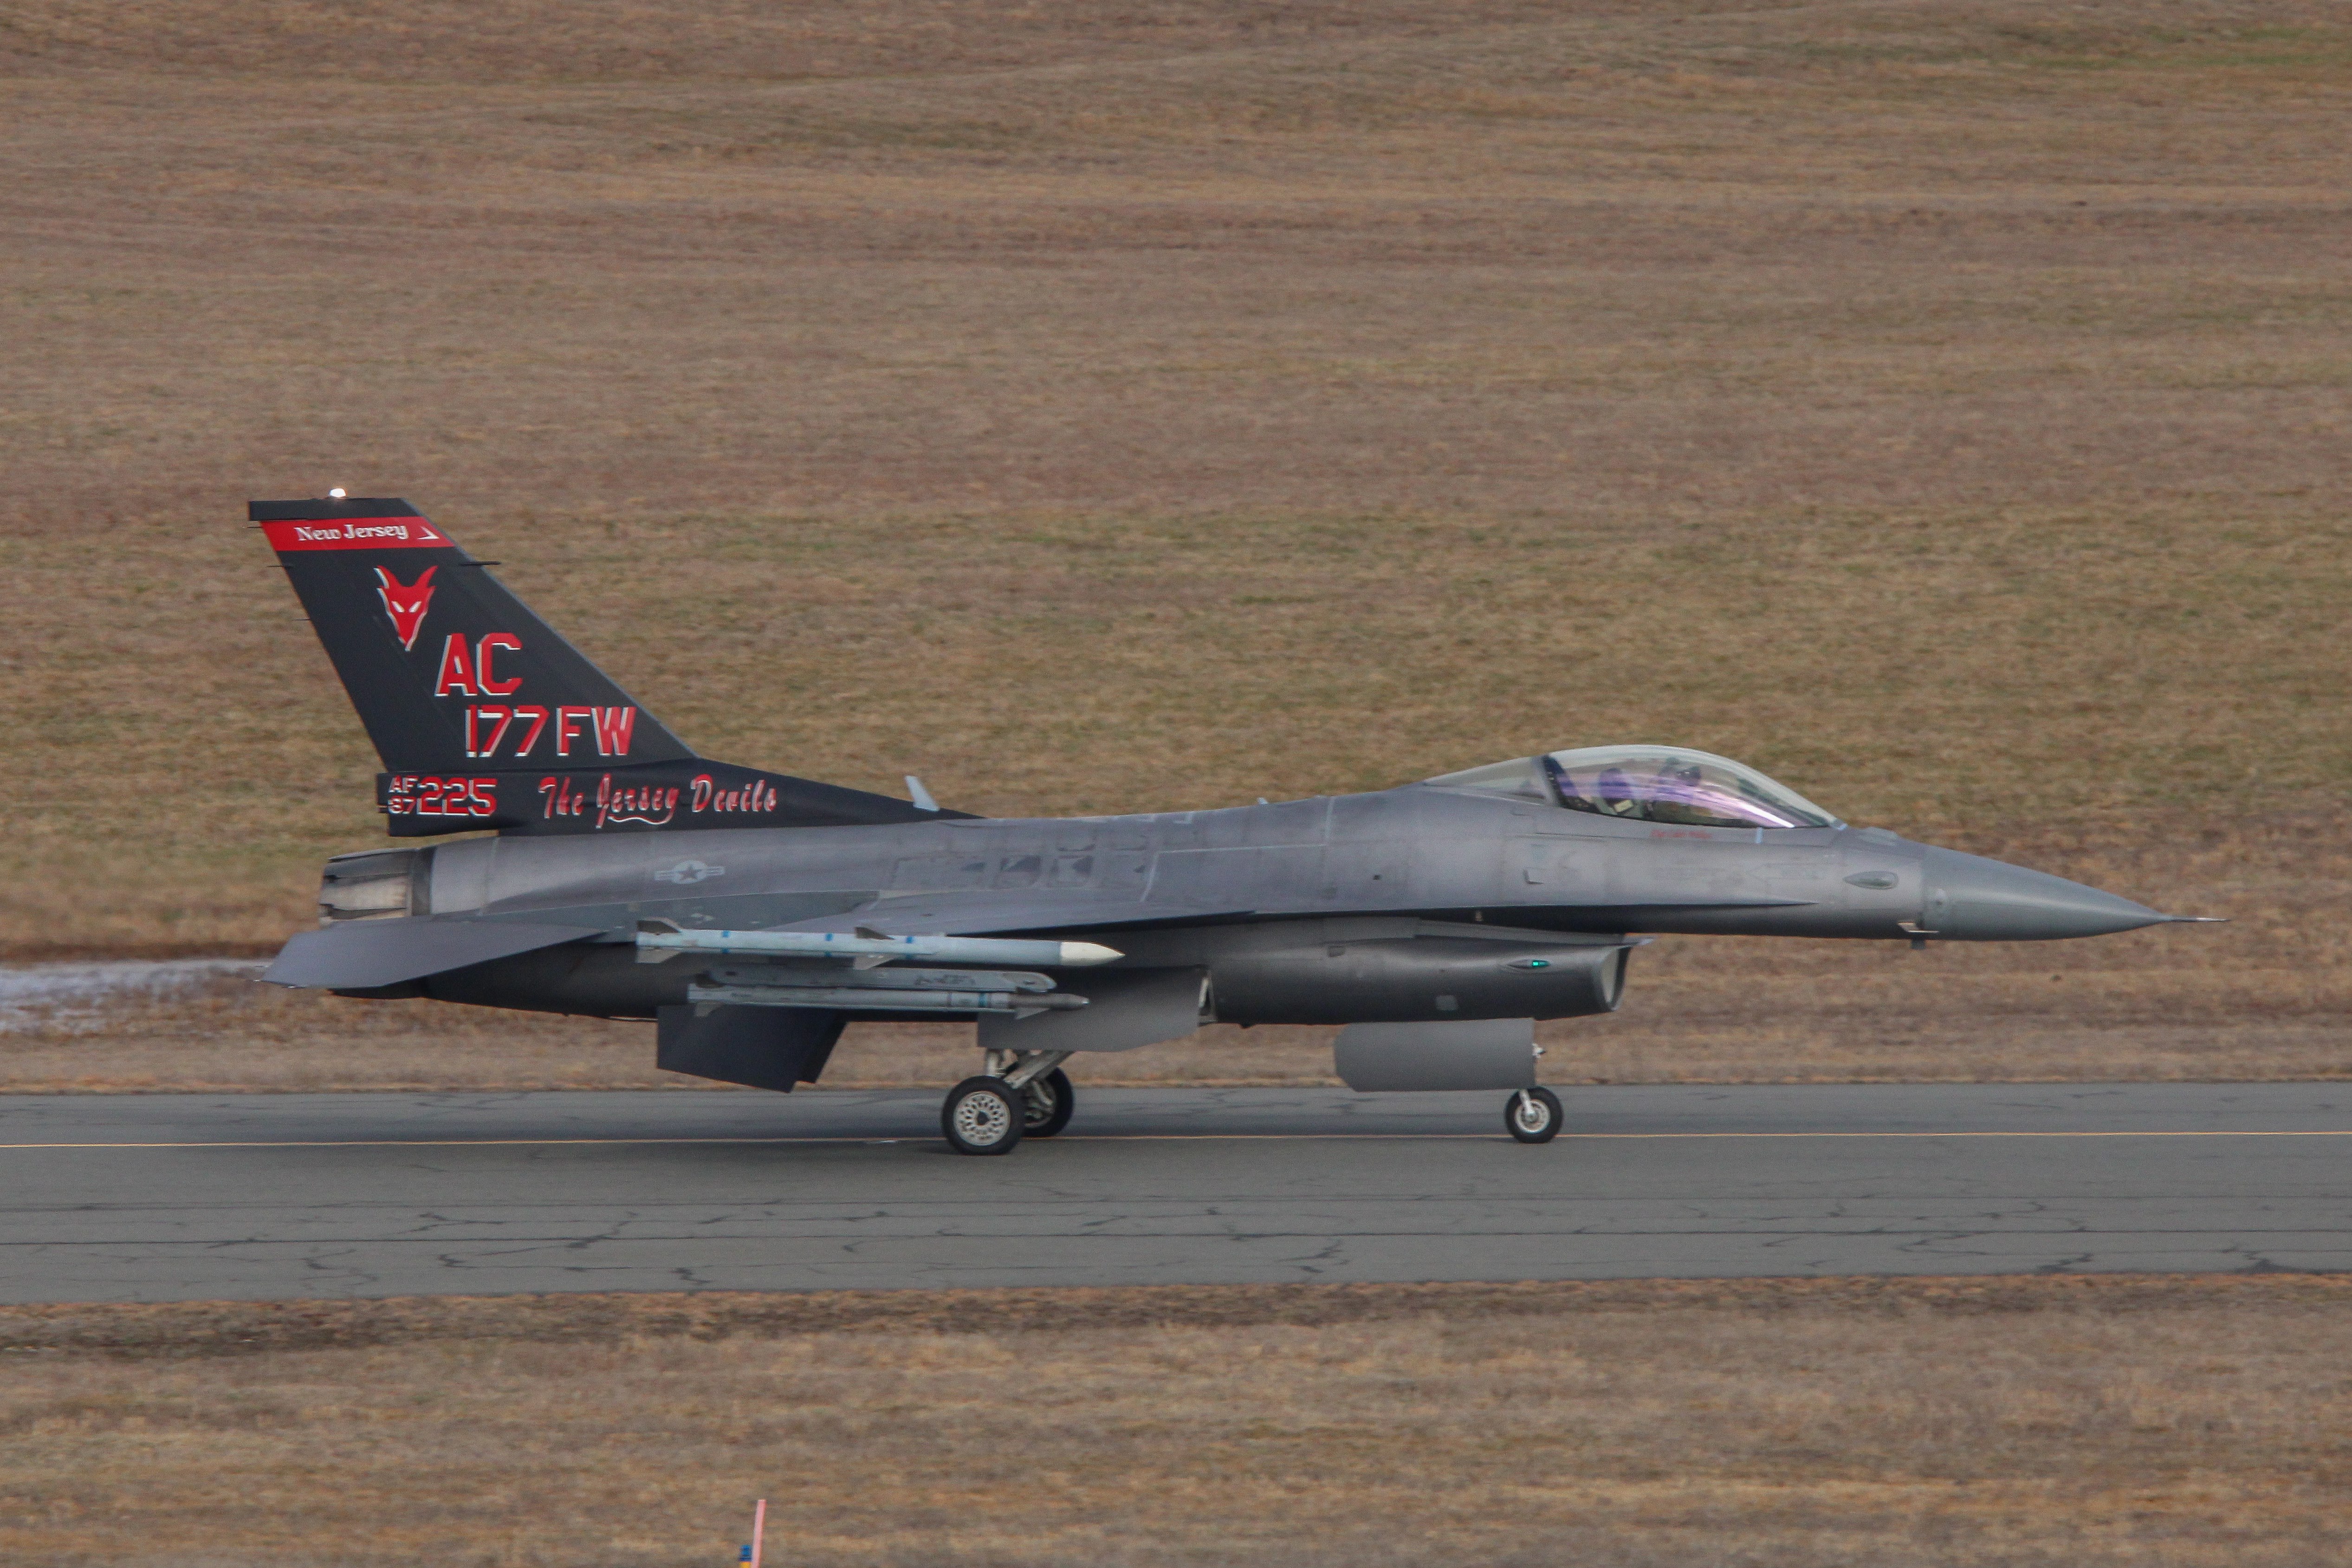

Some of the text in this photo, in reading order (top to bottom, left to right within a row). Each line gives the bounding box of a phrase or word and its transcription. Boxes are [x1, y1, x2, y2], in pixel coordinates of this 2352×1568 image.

[294, 524, 409, 541] New Jersey
[434, 632, 523, 696] AC
[465, 704, 637, 758] 177 FW
[388, 775, 419, 794] AF
[388, 795, 417, 815] 87
[416, 776, 498, 817] 225
[538, 773, 777, 829] The Jersey Devils
